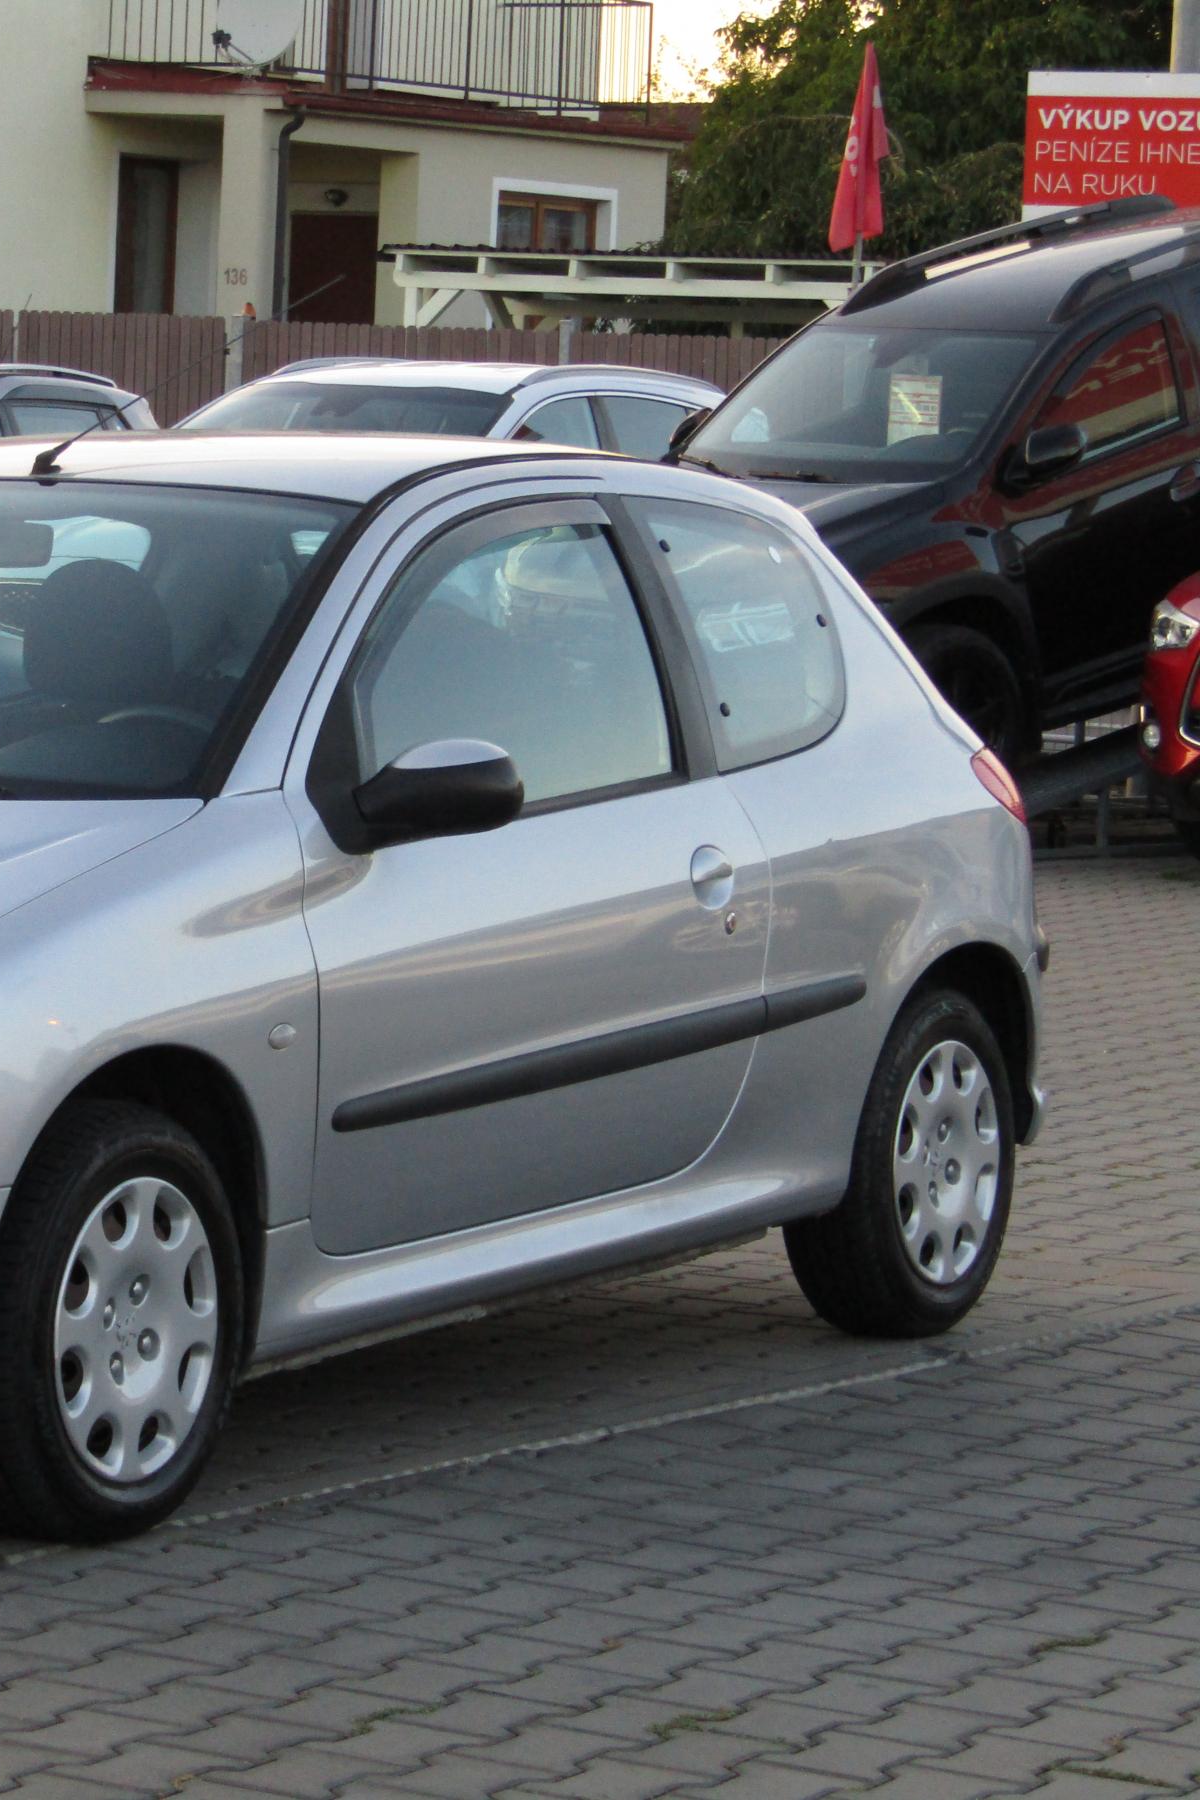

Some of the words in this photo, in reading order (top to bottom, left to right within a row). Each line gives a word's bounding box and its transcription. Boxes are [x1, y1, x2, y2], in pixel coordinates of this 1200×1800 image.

[1037, 103, 1131, 131] VÝKUP
[1138, 109, 1200, 132] VOZ
[1034, 136, 1131, 164] PENÍZE
[1033, 172, 1073, 195] NA
[1081, 173, 1157, 196] RUKU
[224, 267, 248, 286] 136
